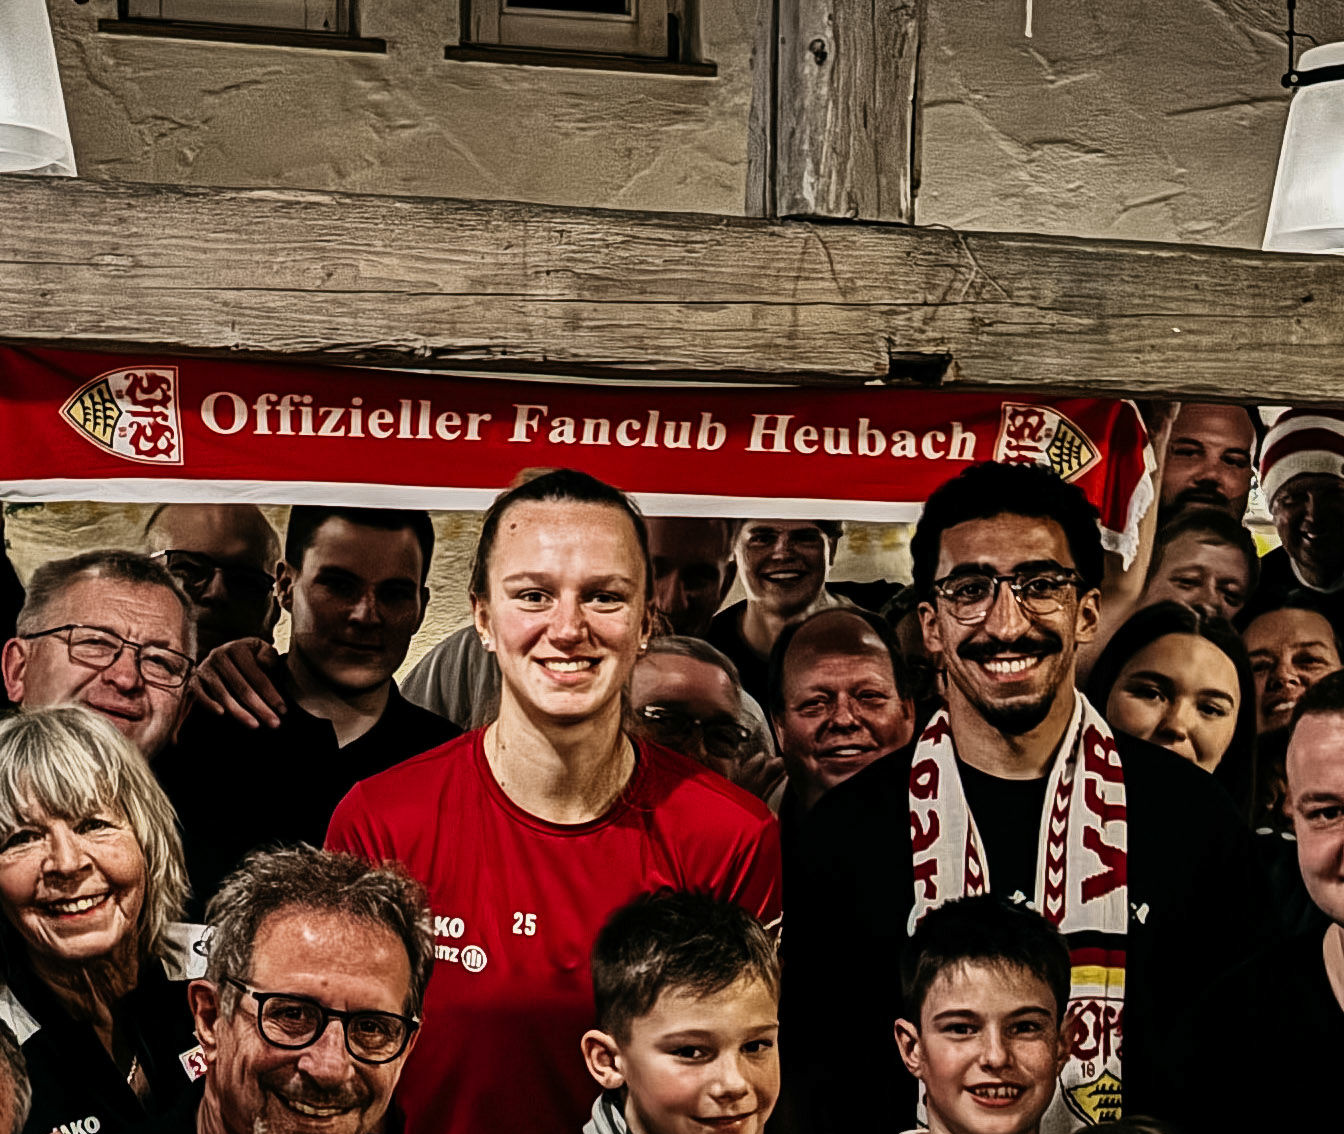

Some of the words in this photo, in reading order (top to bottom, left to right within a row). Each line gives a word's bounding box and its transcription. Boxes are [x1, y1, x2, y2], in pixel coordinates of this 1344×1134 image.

[200, 391, 492, 441] Offizieller
[509, 402, 729, 453] Fanclub
[747, 411, 978, 462] Heubach
[512, 911, 538, 937] 25
